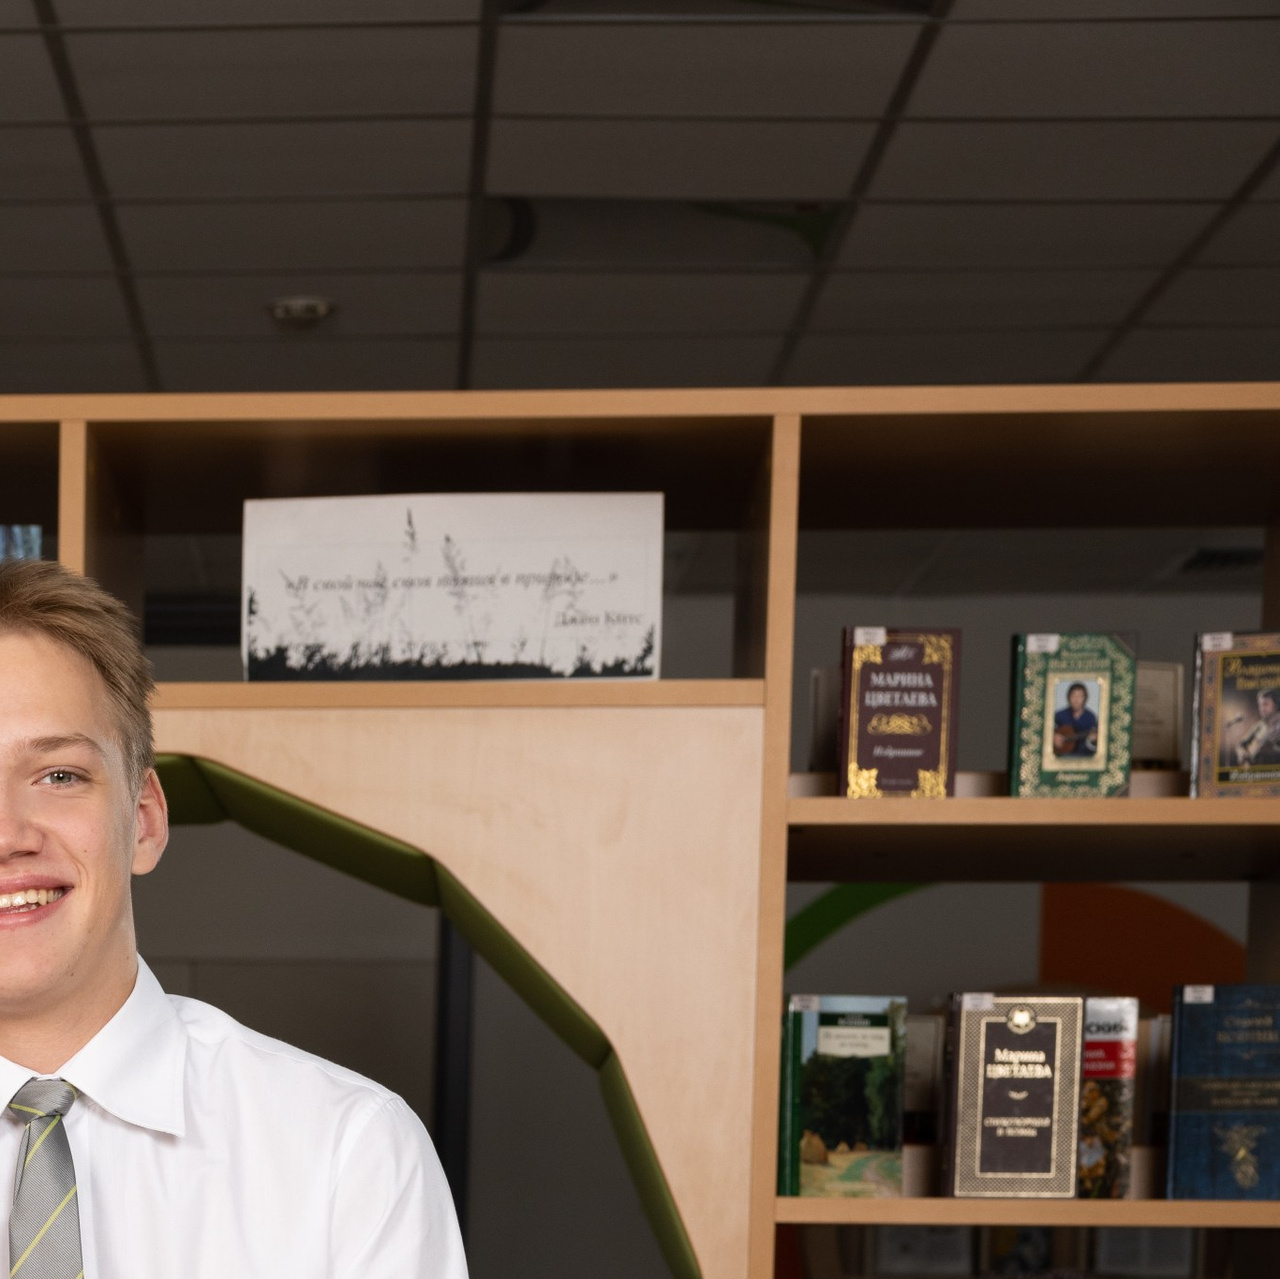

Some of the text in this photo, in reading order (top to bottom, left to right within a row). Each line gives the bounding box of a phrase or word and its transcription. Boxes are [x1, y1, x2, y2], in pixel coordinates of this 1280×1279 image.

[865, 691, 937, 708] ЦВЕТАЕВА
[994, 1048, 1046, 1063] Марина
[986, 1063, 1053, 1079] ЦВЕТАЕВА
